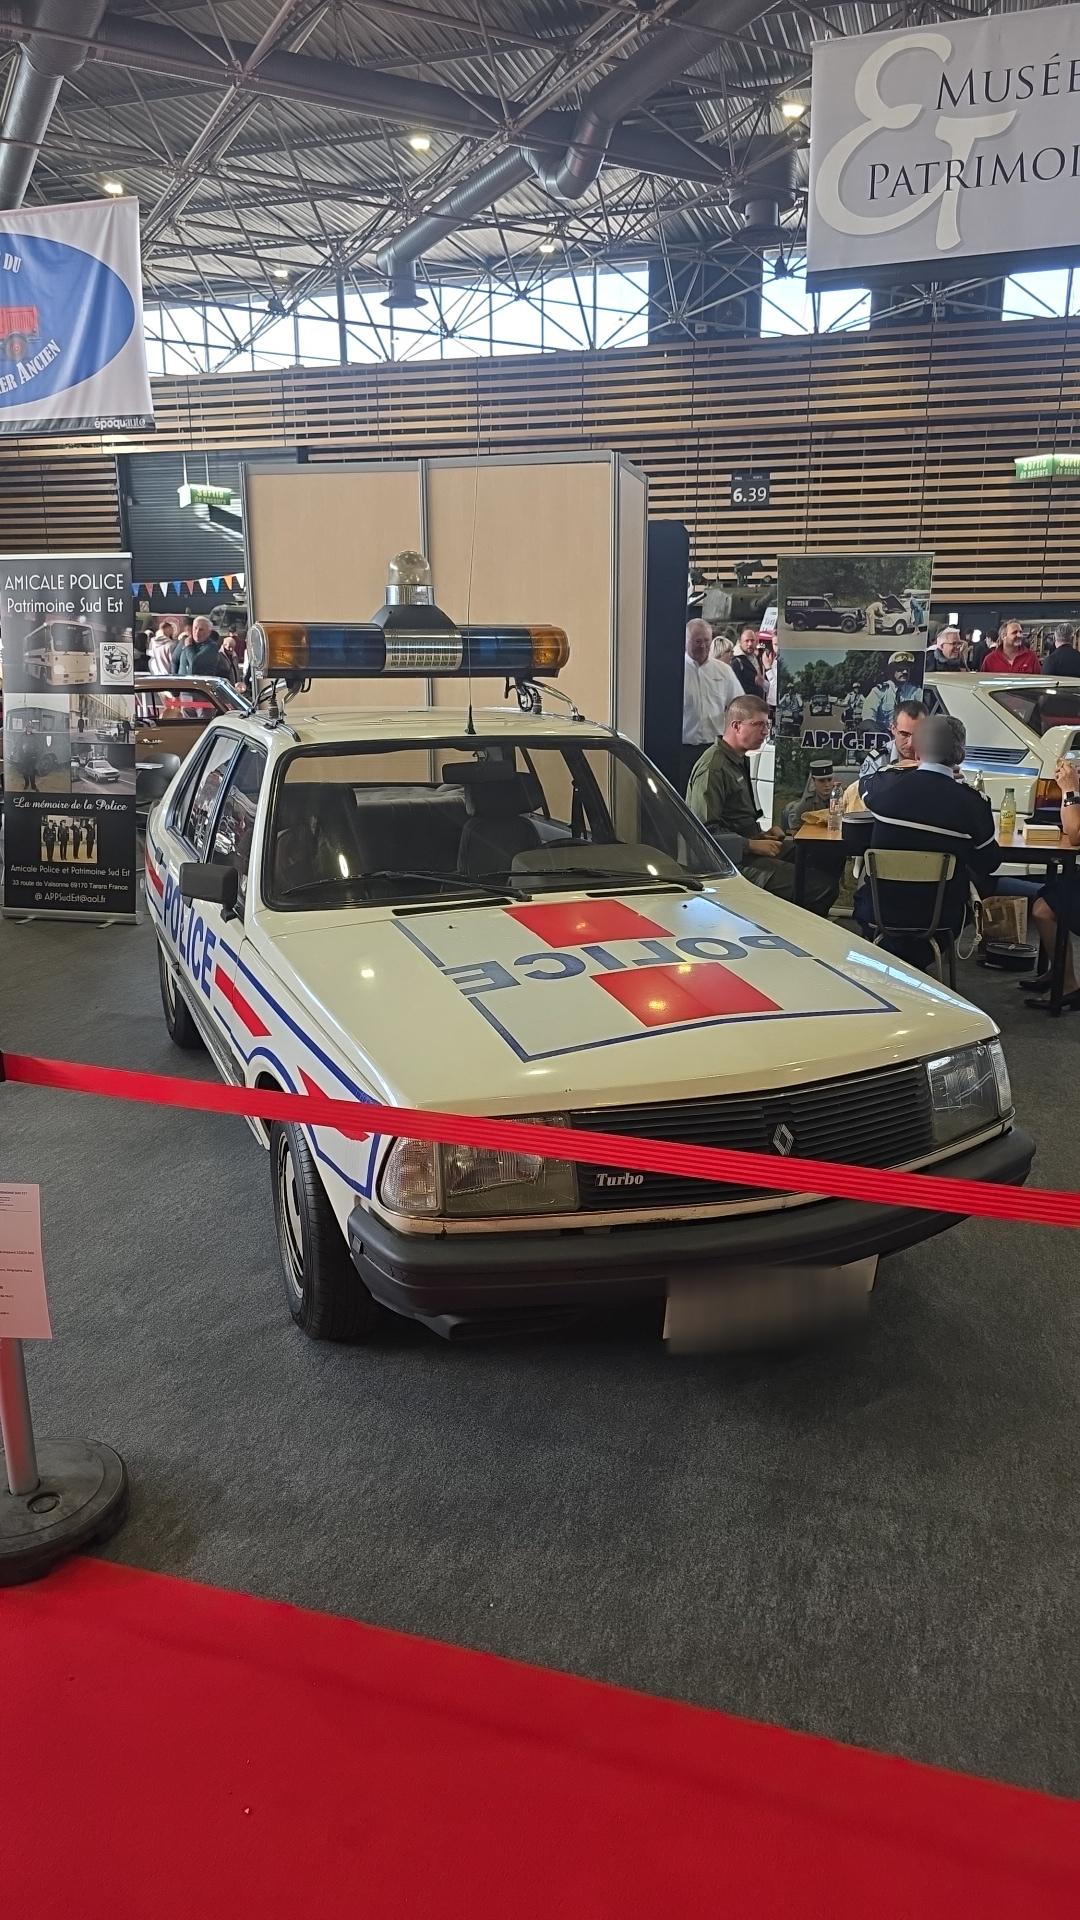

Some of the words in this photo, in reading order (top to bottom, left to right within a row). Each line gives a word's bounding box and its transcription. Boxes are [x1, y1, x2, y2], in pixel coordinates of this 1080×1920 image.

[3, 253, 21, 273] DU
[16, 339, 61, 385] ANCIEN
[733, 487, 767, 502] 6.39
[5, 574, 64, 590] AMICALE
[70, 574, 124, 590] POLICE
[7, 597, 75, 613] Patrimoine
[80, 597, 102, 613] Sud
[107, 597, 124, 613] Est
[13, 797, 31, 808] La
[32, 799, 70, 809] mémoire
[70, 800, 83, 810] de
[83, 800, 95, 810] la
[95, 798, 129, 811] Police
[11, 865, 38, 873] Amicale
[40, 865, 61, 874] Police
[71, 866, 107, 876] Patrimoine
[108, 867, 120, 876] Sud
[122, 868, 131, 877] Est
[70, 880, 88, 889] 69170
[109, 882, 129, 891] France
[164, 873, 217, 1000] POLICE
[596, 1172, 644, 1187] Turbo
